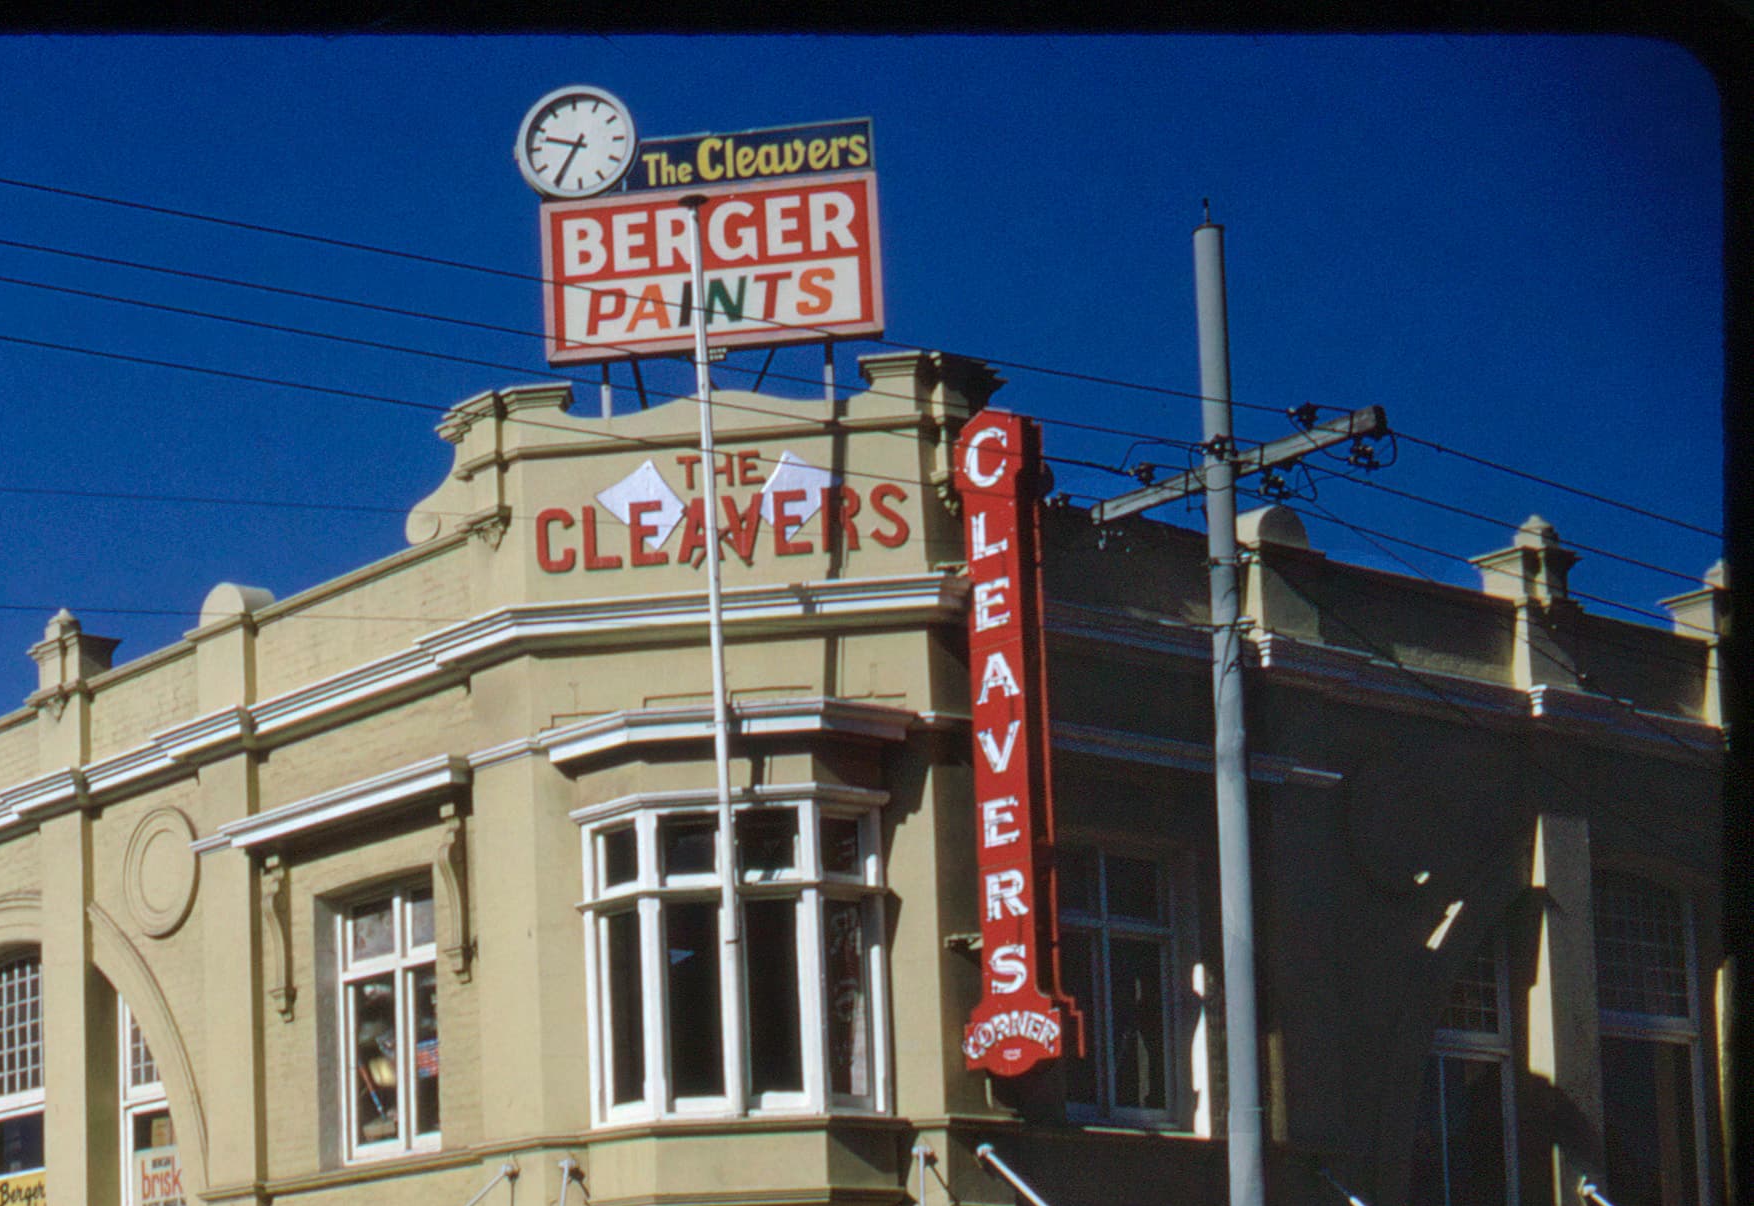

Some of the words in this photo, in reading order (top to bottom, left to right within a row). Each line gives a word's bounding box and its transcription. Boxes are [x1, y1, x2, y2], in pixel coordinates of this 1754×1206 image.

[642, 151, 693, 187] The
[697, 132, 869, 182] Cleavers
[561, 190, 859, 277] BERGER
[586, 266, 836, 338] PAINTS
[676, 449, 767, 491] THE
[535, 481, 911, 574] CLEAVERS
[964, 428, 1029, 996] CLEAVERS
[961, 1009, 1061, 1060] CORNER
[141, 1155, 183, 1201] brisk
